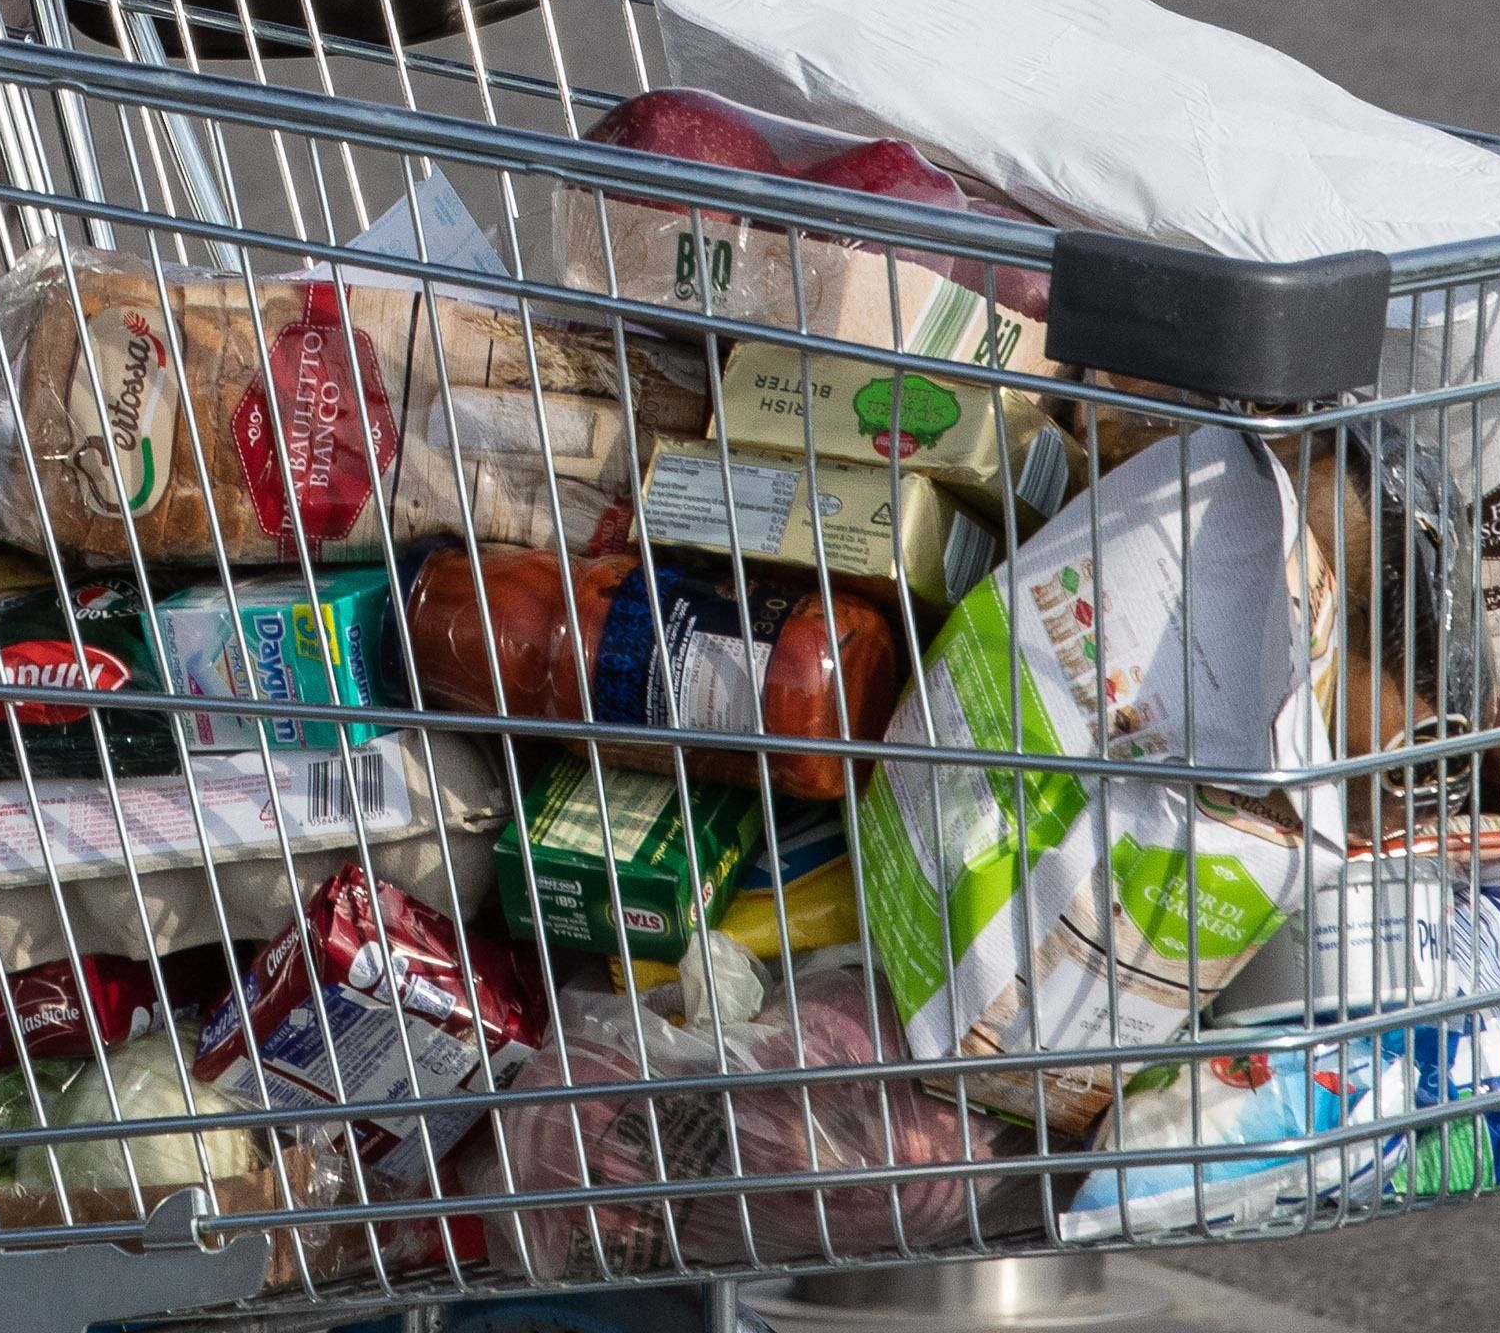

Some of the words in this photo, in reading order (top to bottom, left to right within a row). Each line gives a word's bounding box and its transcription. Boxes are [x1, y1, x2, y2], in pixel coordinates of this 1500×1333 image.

[675, 232, 733, 292] BO
[290, 331, 324, 473] BAULETTO
[760, 396, 806, 418] RISH
[309, 380, 341, 488] BIANCO
[622, 908, 662, 931] STA
[1220, 903, 1245, 923] DI
[17, 1005, 81, 1034] lassiche
